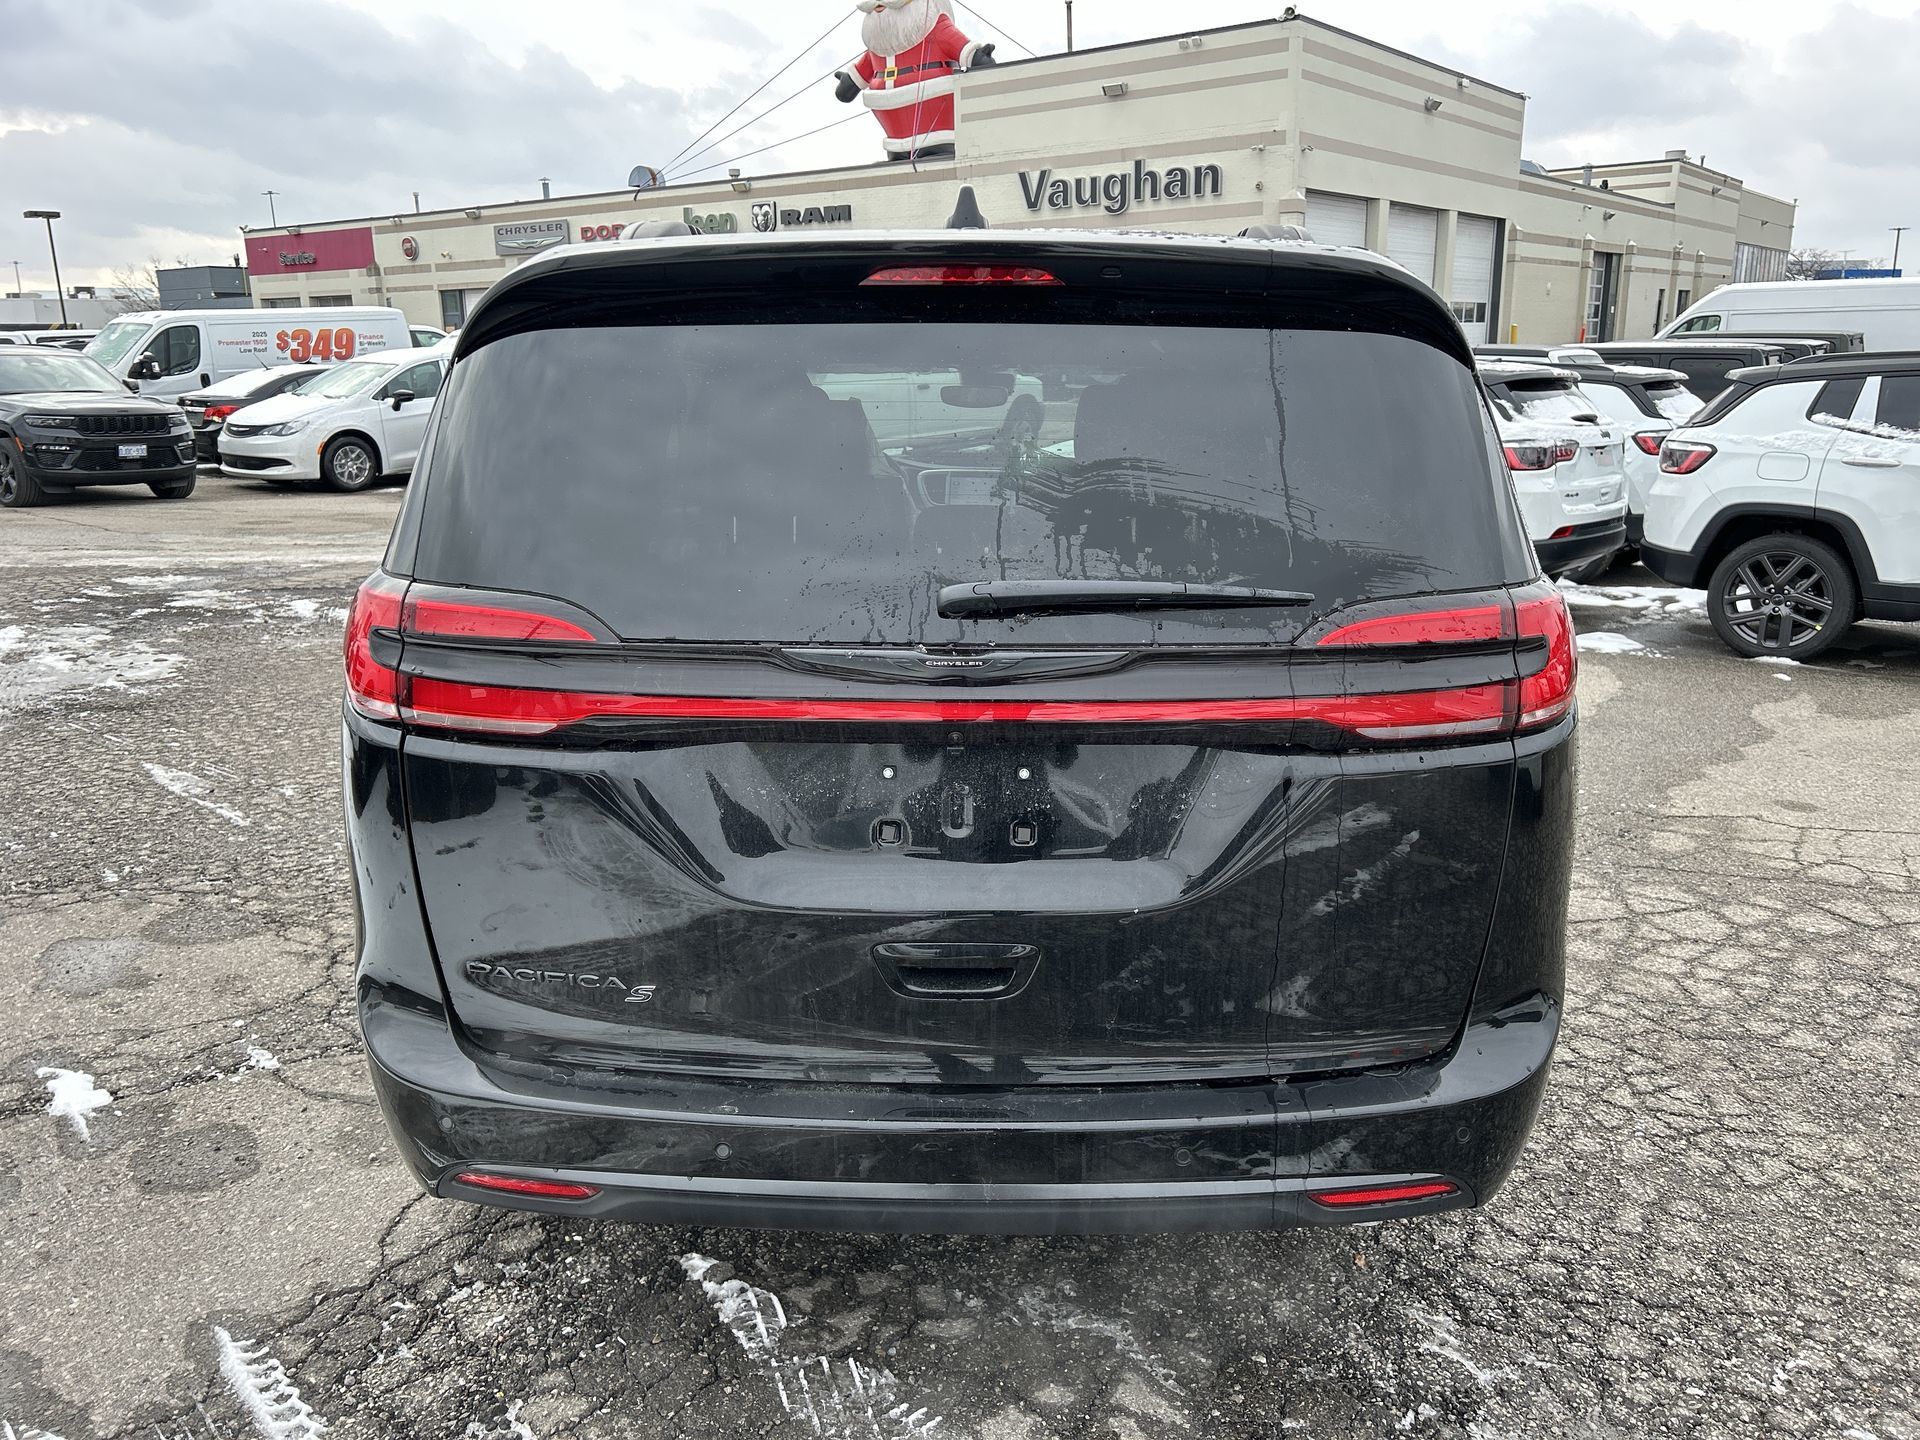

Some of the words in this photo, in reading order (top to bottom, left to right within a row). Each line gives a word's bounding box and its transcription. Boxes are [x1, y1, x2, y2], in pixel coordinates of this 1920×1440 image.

[1018, 159, 1223, 215] Vaughan
[780, 205, 852, 227] RAM
[497, 223, 563, 236] CHRYSLER
[581, 224, 625, 241] DOD
[279, 251, 315, 265] Service
[252, 338, 268, 346] 1500
[276, 328, 355, 362] $349
[465, 961, 627, 990] PACIFICA
[624, 985, 656, 1003] S
